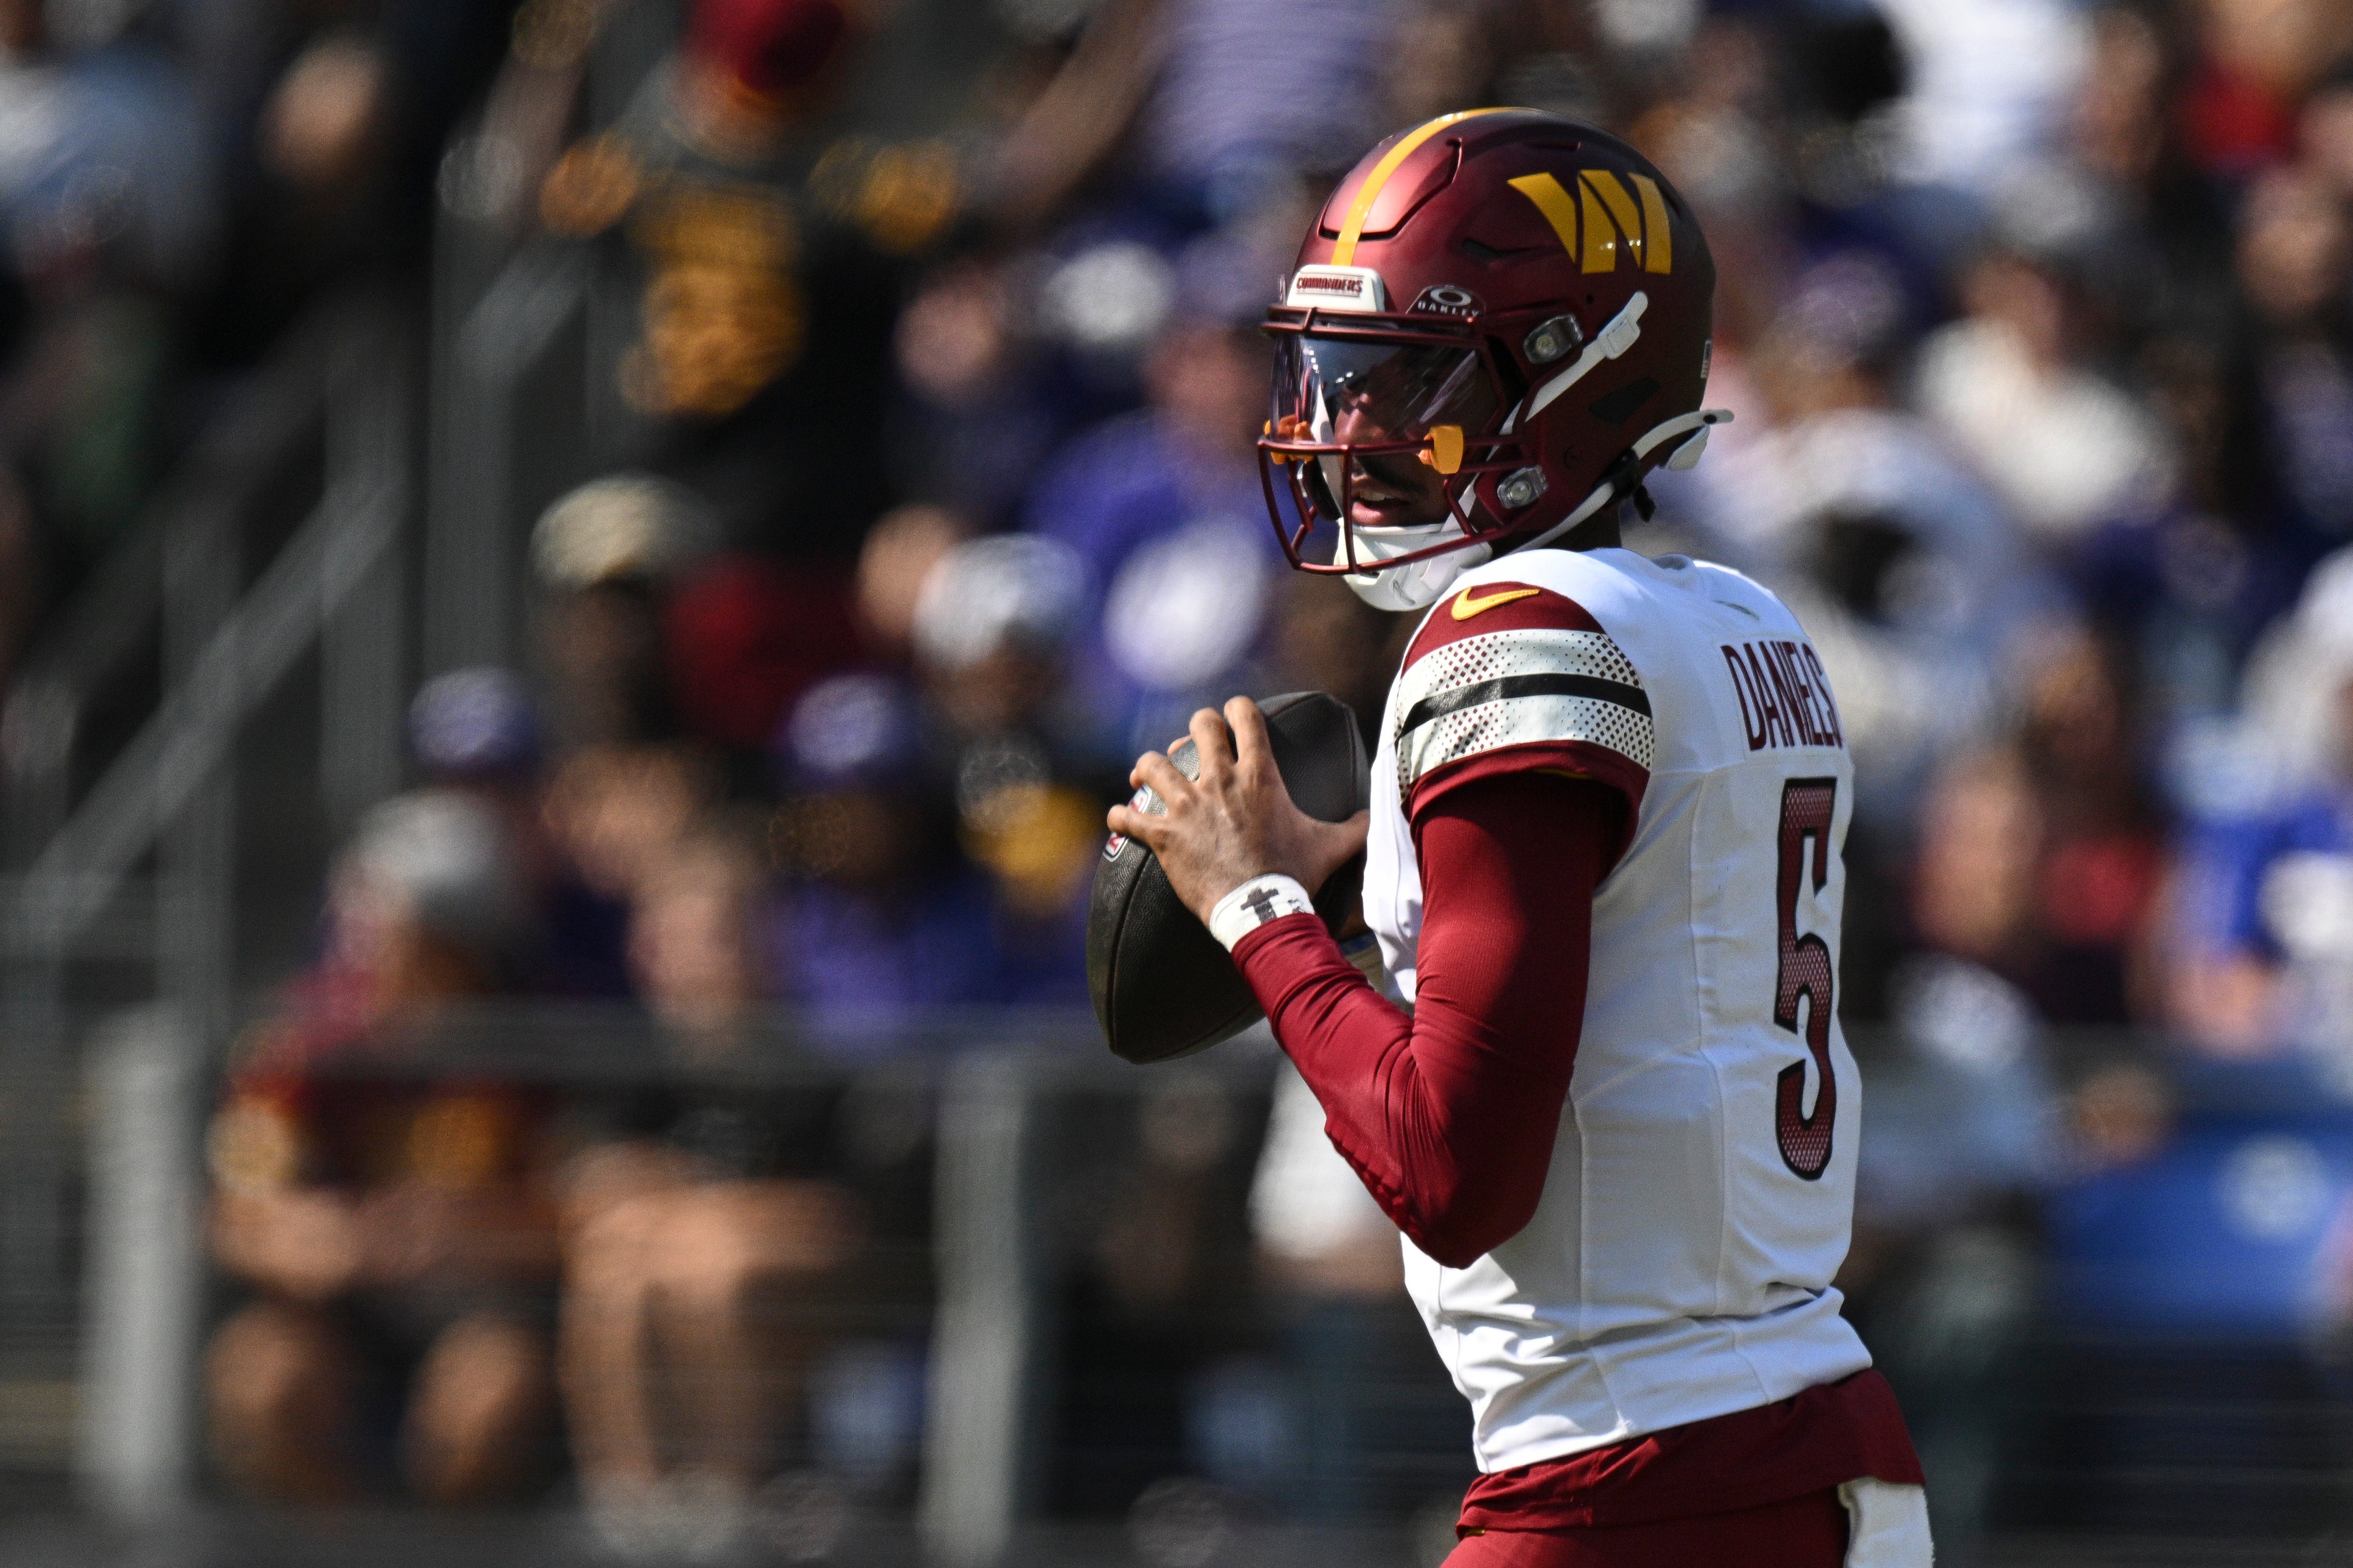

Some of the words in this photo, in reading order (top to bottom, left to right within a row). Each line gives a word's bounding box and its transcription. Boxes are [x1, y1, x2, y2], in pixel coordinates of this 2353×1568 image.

[1296, 276, 1363, 293] COMMANDERS
[1418, 301, 1480, 318] OAKLEY
[1721, 641, 1842, 751] DANIELS
[1774, 776, 1837, 1181] 5
